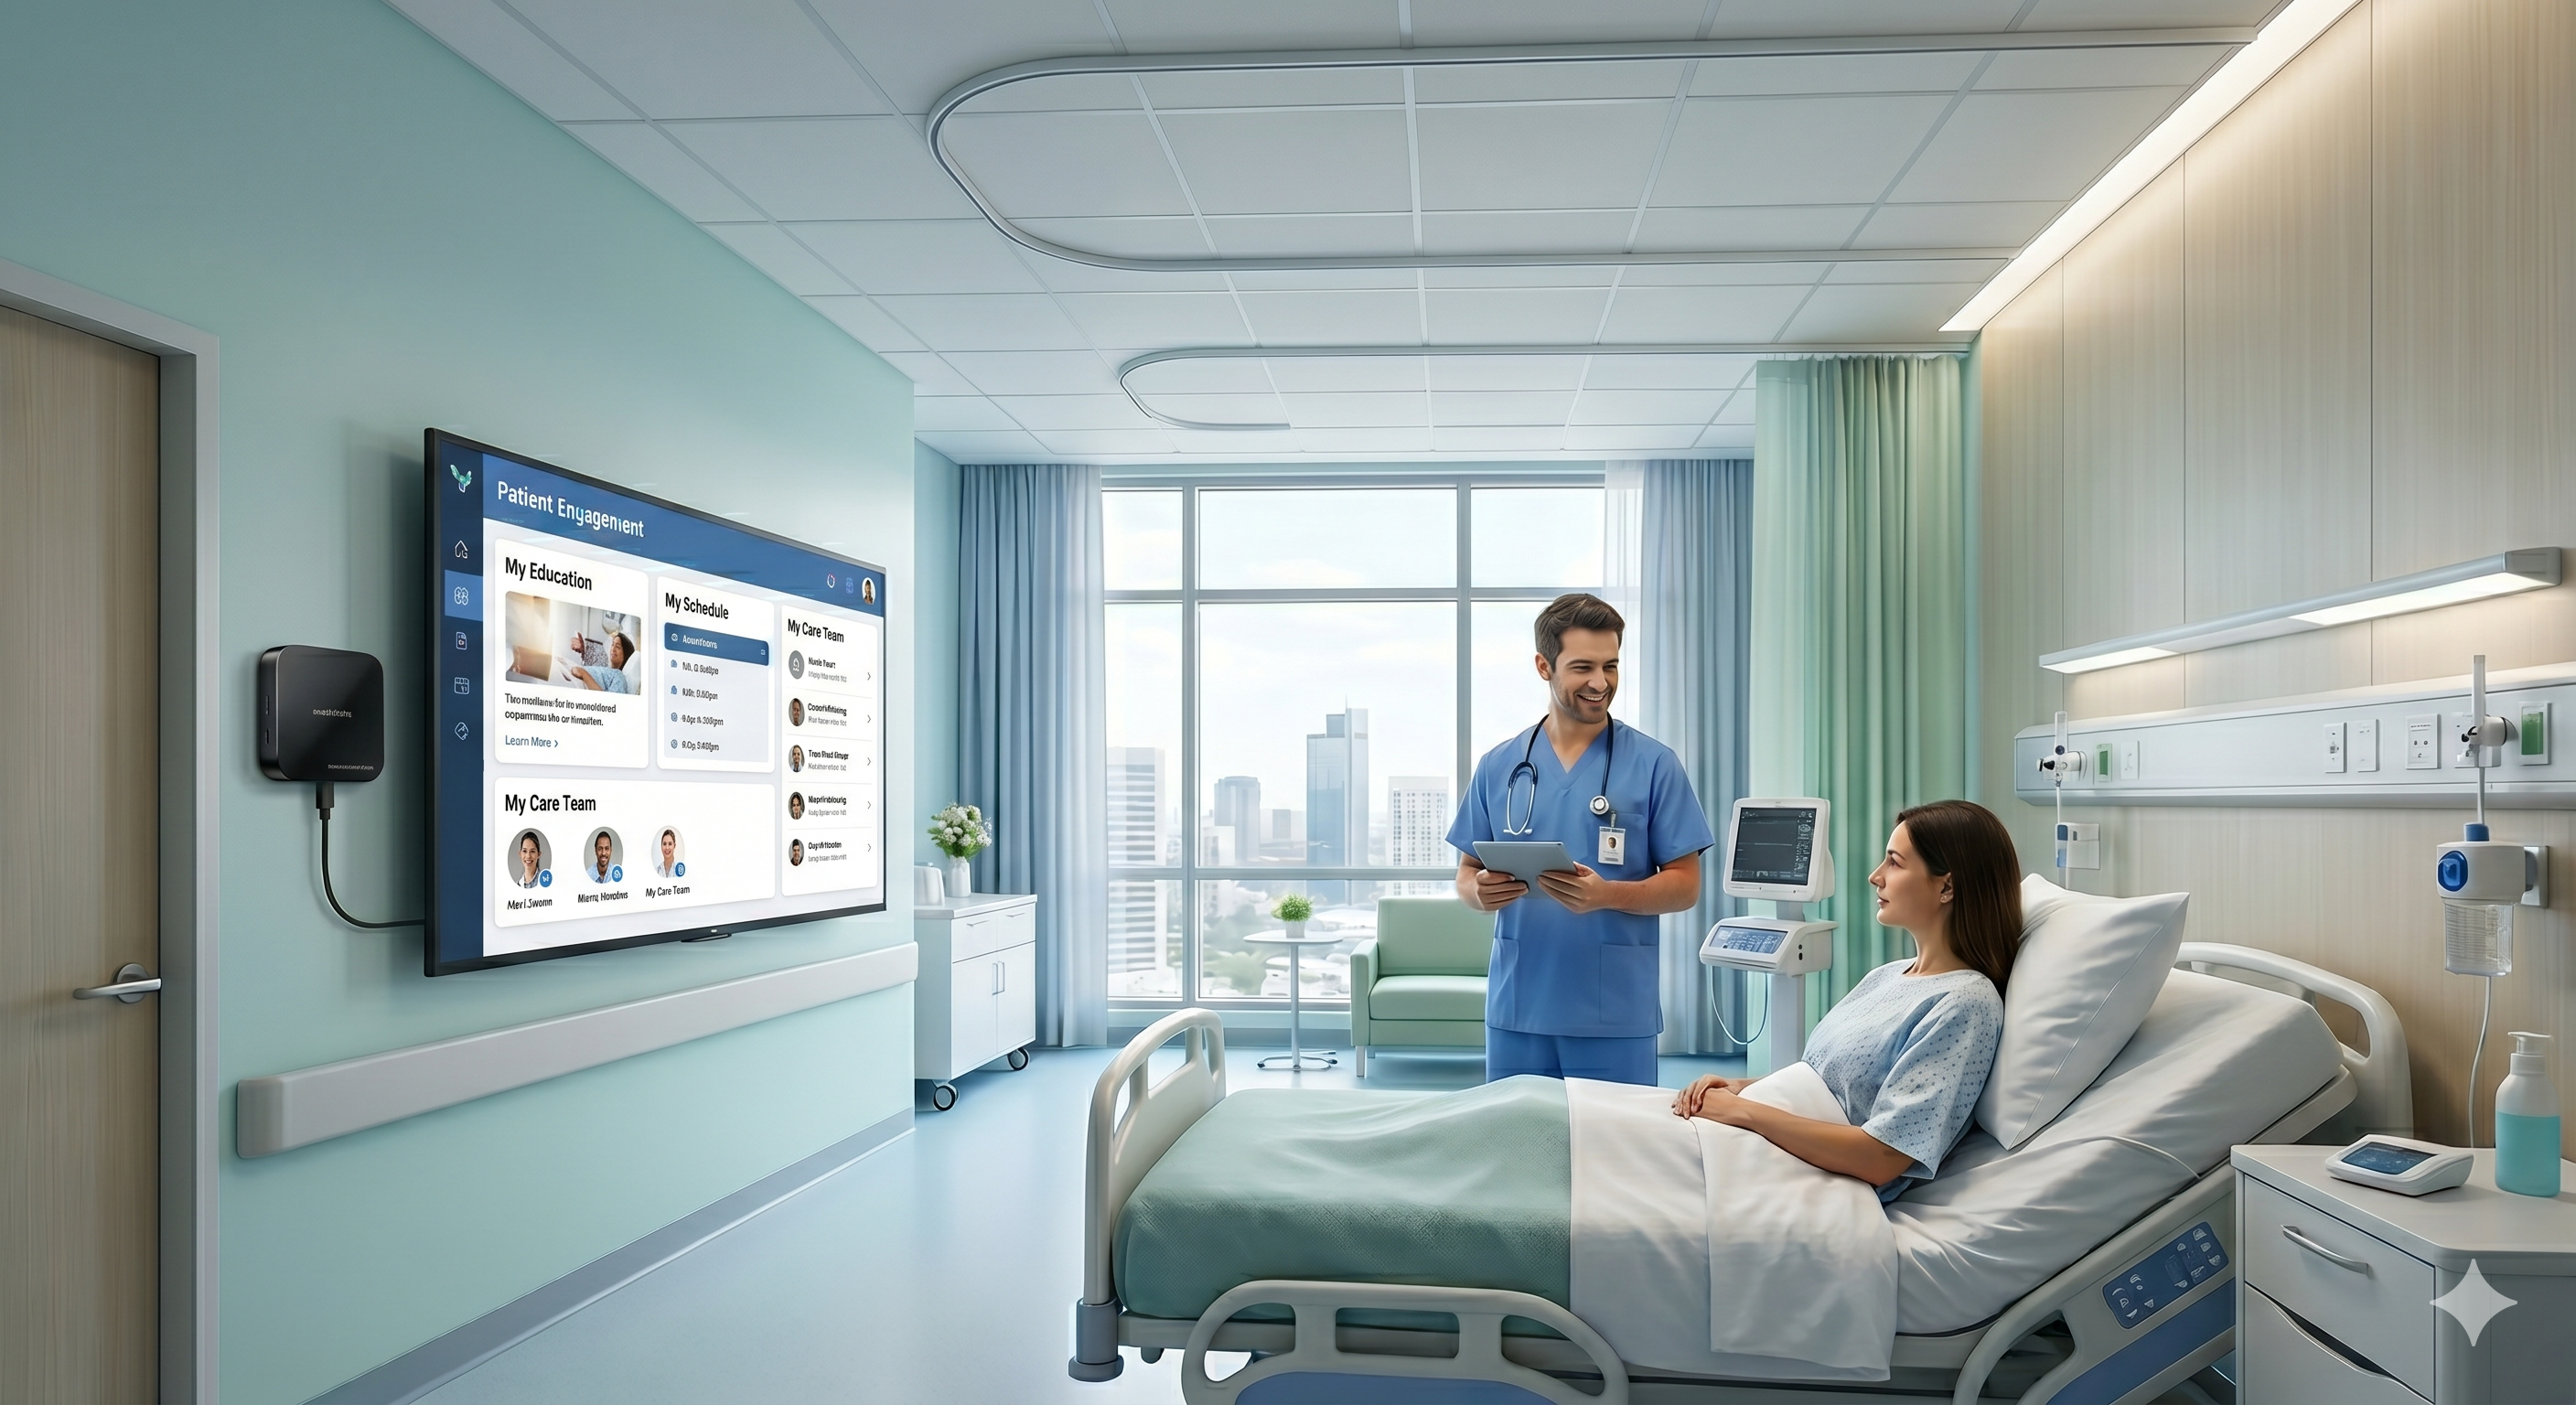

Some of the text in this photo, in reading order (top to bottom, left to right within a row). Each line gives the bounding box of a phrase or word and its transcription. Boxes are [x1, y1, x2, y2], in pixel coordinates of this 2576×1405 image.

[498, 480, 553, 513] Patient
[505, 556, 593, 591] My Education
[665, 593, 729, 619] My Schedule
[788, 618, 844, 642] My Care Team
[505, 735, 552, 747] Learn More
[505, 794, 596, 816] My Care Team
[645, 885, 691, 897] My Care Team
